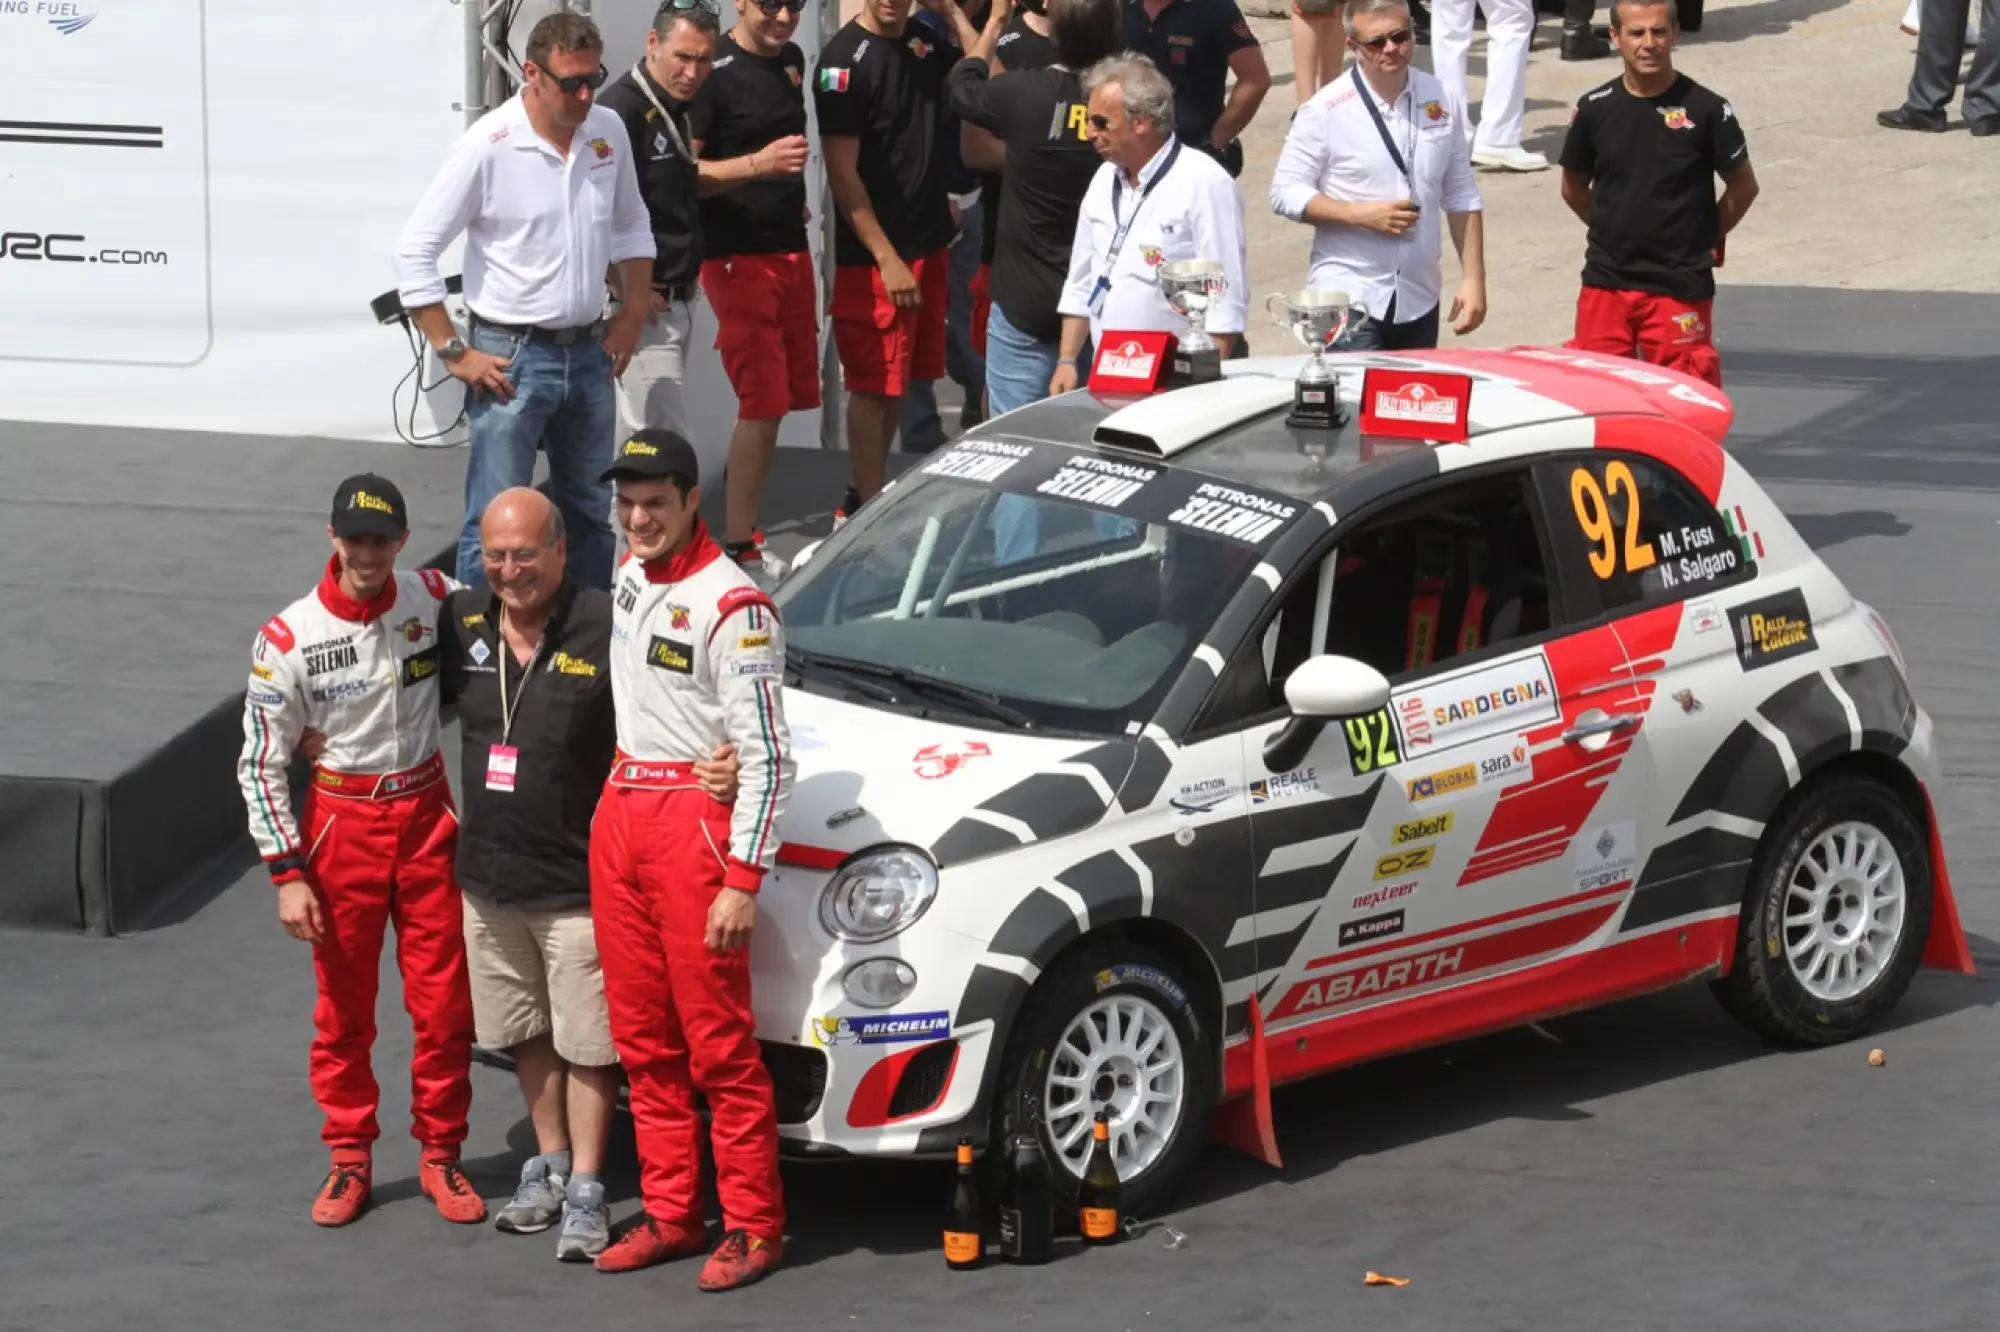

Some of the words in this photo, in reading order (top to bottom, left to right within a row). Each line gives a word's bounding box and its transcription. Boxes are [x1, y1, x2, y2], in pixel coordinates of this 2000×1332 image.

[36, 3, 80, 16] FUEL
[1066, 456, 1156, 481] PETRONAS
[1036, 467, 1144, 508] SELENIA
[1196, 483, 1296, 518] PETRONAS
[1167, 495, 1284, 544] SELENIA
[1570, 460, 1656, 580] 92
[1659, 532, 1681, 557] M.
[1681, 526, 1715, 550] Fusi
[1660, 564, 1679, 588] N.
[1681, 549, 1736, 583] Salgaro
[305, 645, 358, 677] SELENIA
[1433, 679, 1548, 726] SARDEGNA
[1399, 697, 1433, 749] 2016
[1345, 710, 1398, 772] 92
[1270, 767, 1317, 789] REALE
[1434, 768, 1477, 790] GLOBAL
[1481, 754, 1511, 775] sara
[1194, 777, 1226, 793] ACTION
[1398, 815, 1447, 843] Sabelt
[1379, 850, 1428, 875] OZ
[1580, 868, 1628, 890] SPORT
[1359, 917, 1401, 935] Kappa
[1295, 948, 1465, 1011] ABARTH
[863, 1018, 948, 1034] MICHELIN
